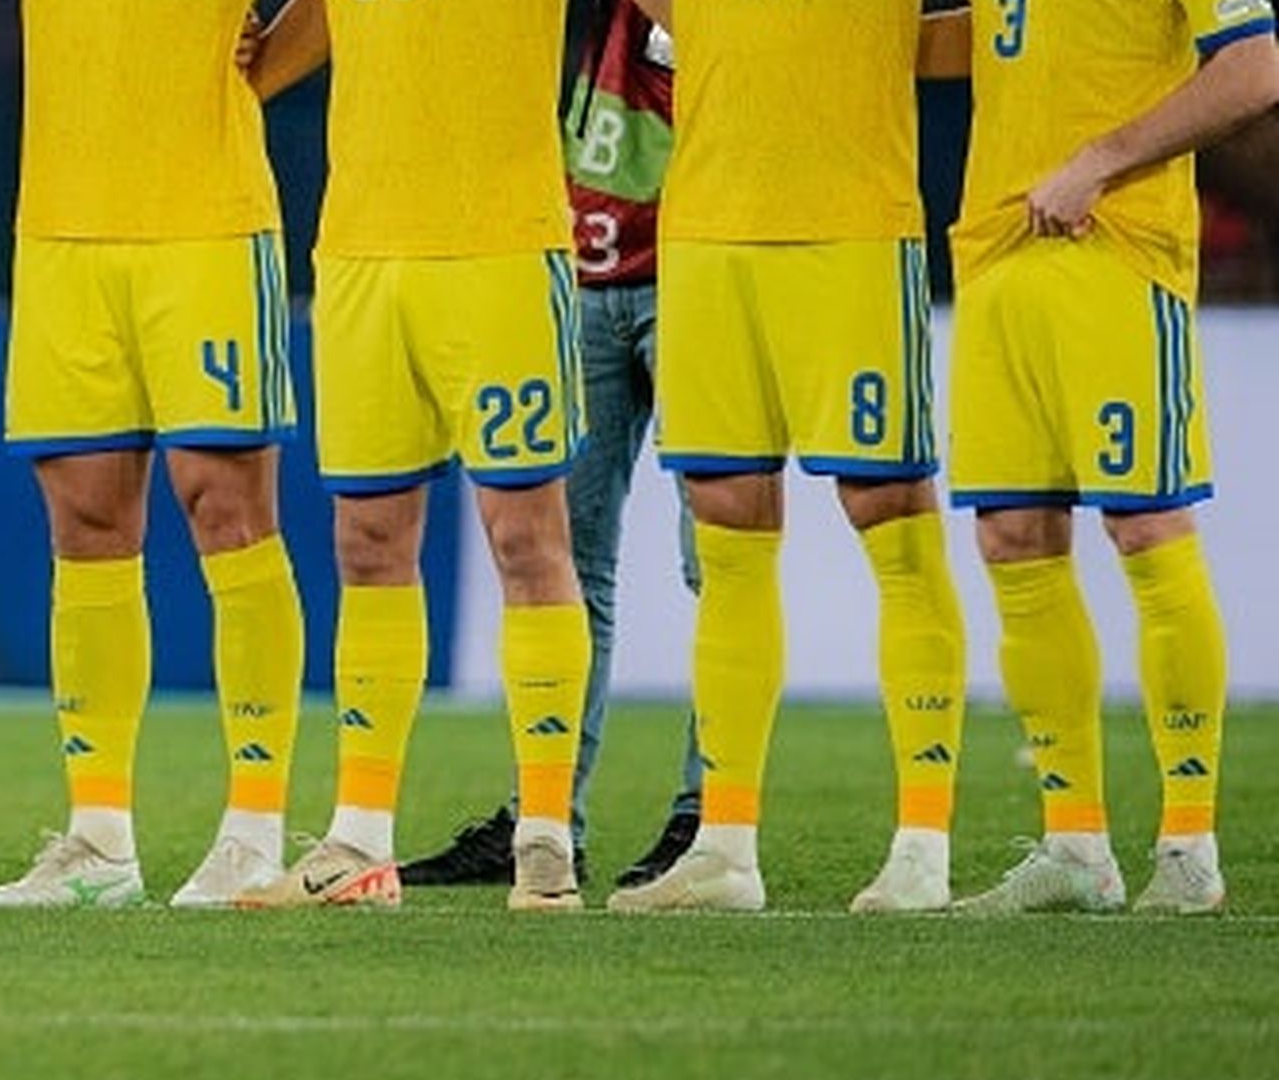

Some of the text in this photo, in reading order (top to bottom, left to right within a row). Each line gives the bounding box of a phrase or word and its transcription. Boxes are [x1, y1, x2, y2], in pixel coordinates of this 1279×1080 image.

[576, 211, 619, 274] 3
[201, 338, 242, 413] 4
[850, 370, 888, 448] 8
[475, 377, 557, 461] 22
[1097, 400, 1136, 478] 3
